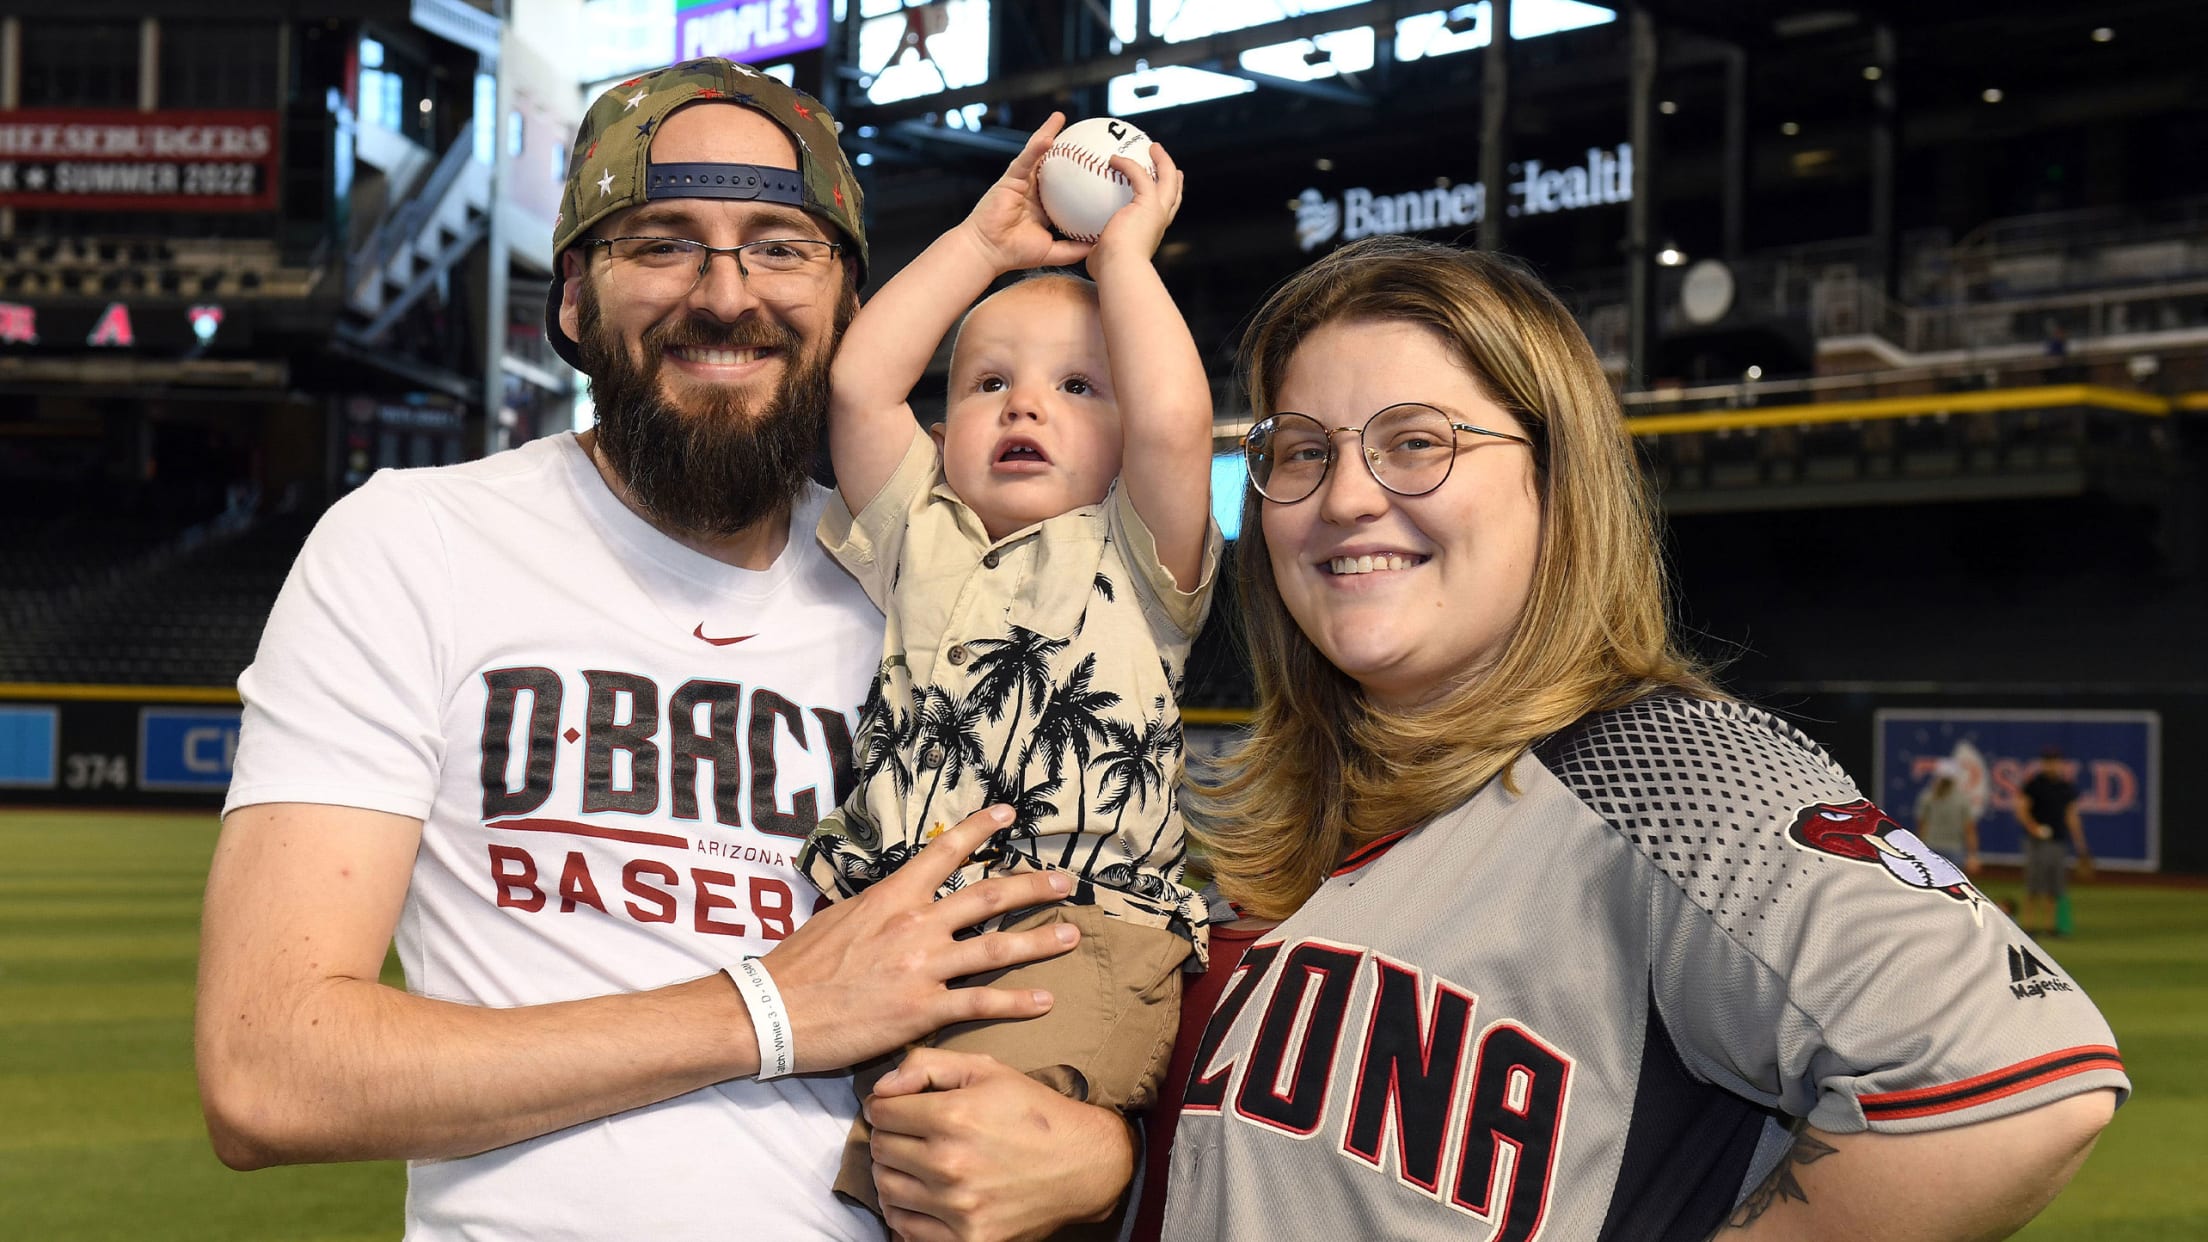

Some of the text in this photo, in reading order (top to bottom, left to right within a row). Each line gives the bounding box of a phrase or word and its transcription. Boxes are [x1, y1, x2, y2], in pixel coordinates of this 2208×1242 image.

[55, 162, 178, 194] SUMMER
[183, 163, 256, 194] 2022
[1507, 142, 1634, 216] Healt
[64, 754, 128, 790] 374
[697, 838, 785, 867] ARIZONA
[488, 843, 834, 940] BASEB
[2009, 978, 2075, 1001] Majestic
[772, 1021, 785, 1052] White
